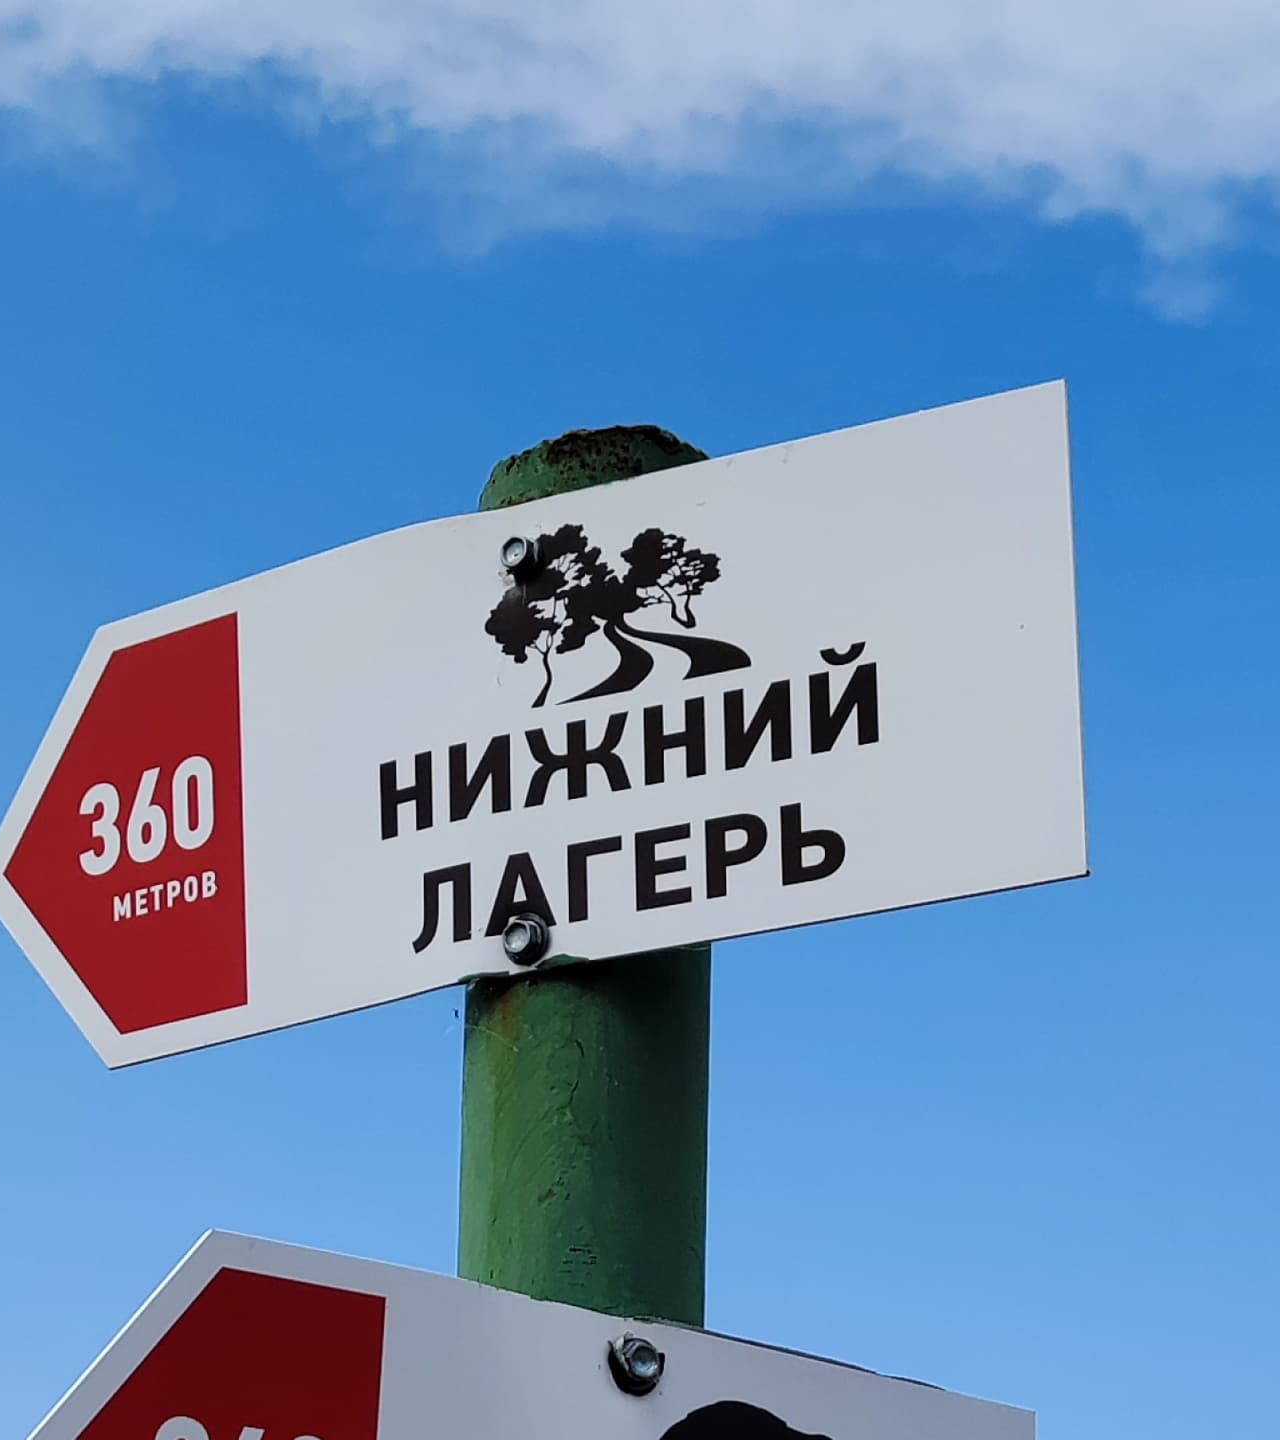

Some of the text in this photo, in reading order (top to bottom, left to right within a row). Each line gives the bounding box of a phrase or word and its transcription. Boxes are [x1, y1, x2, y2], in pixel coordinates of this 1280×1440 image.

[379, 641, 879, 840] НИЖНИЙ
[79, 756, 214, 876] 360
[412, 803, 846, 955] ЛАГЕРЬ
[113, 870, 218, 922] МЕТРОВ
